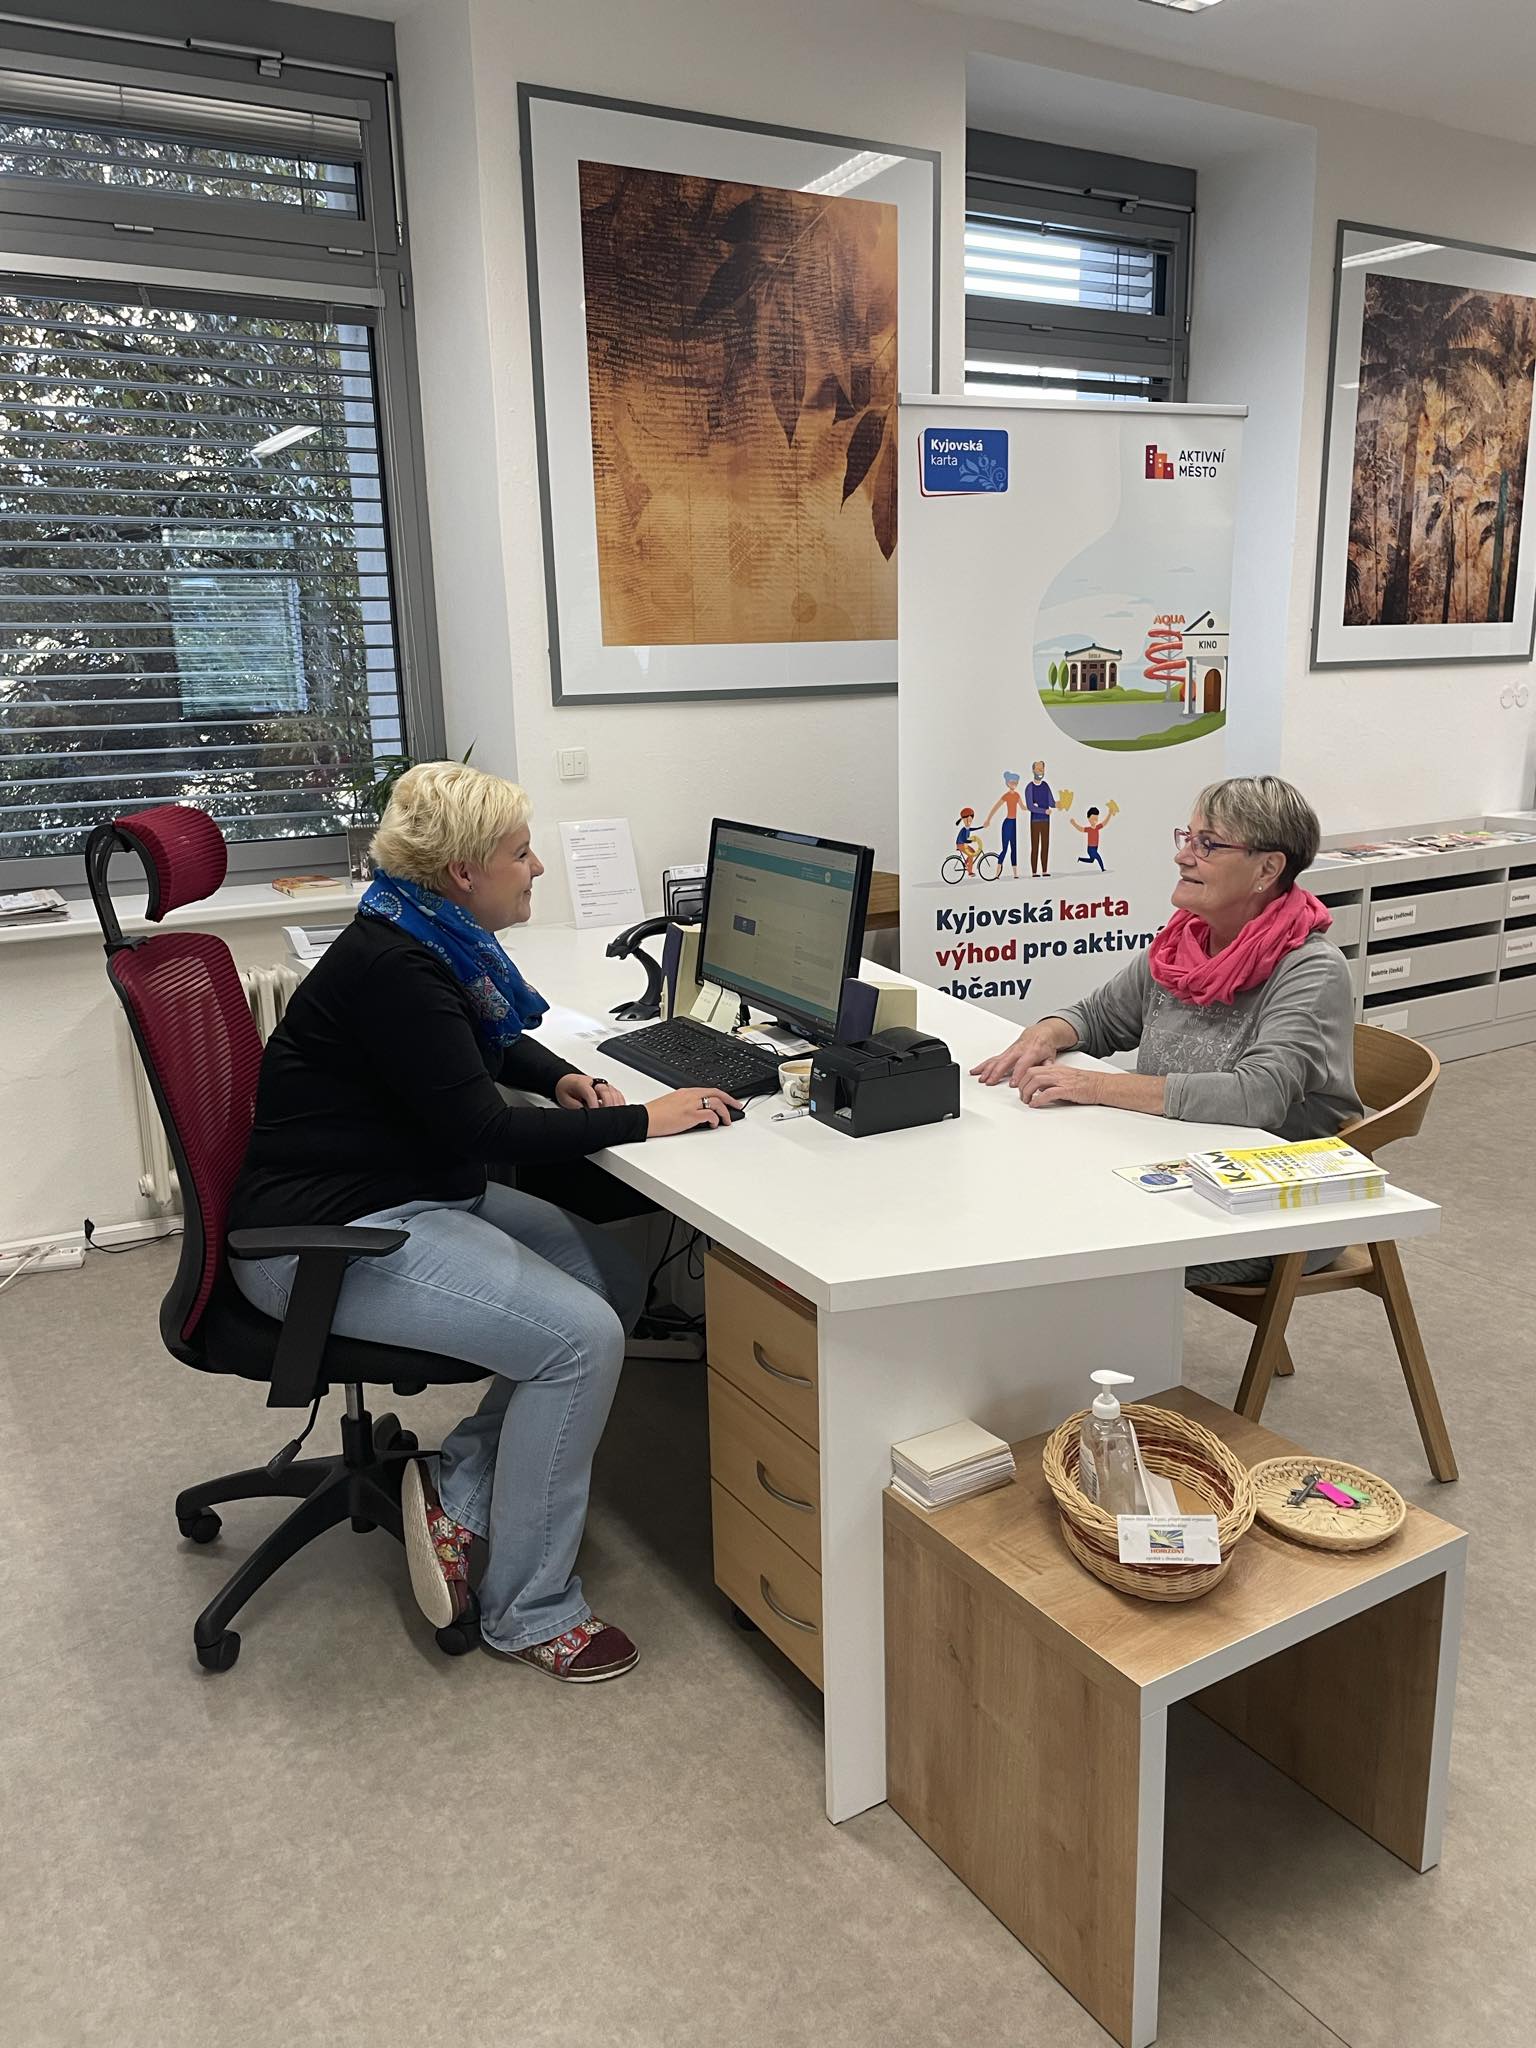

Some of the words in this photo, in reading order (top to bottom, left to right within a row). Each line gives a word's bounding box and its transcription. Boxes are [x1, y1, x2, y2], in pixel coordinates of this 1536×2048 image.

[930, 438, 984, 454] Kyjovská
[930, 453, 958, 466] karta
[1178, 448, 1227, 464] AKTIVNÍ
[1178, 461, 1218, 479] MĚSTO
[1153, 614, 1186, 626] AQUA
[1198, 640, 1218, 650] KINO
[936, 898, 1054, 935] Kyjovská
[1059, 895, 1130, 921] karta
[935, 938, 1017, 971] výhod
[1023, 939, 1067, 964] pro
[1201, 1151, 1252, 1183] KAM
